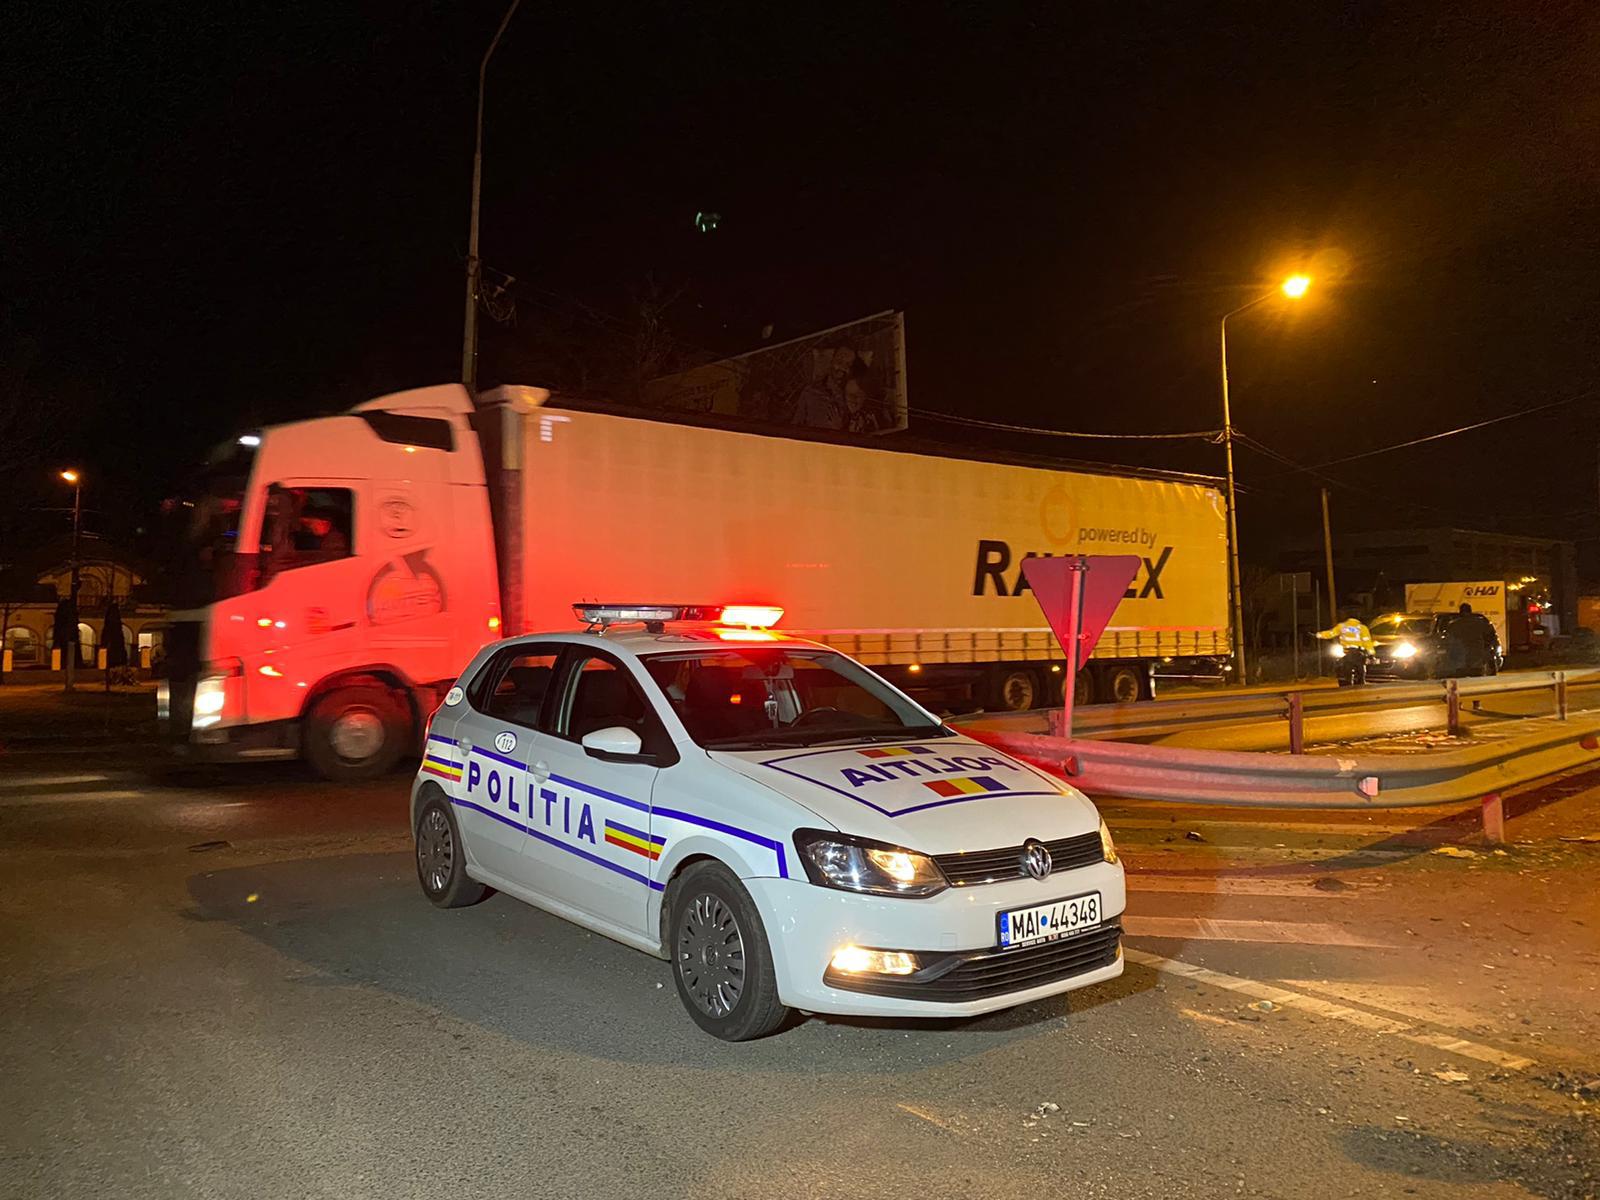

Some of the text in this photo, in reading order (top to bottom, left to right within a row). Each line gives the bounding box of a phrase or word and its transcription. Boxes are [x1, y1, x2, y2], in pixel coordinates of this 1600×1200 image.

[1077, 527, 1157, 549] powered by
[502, 738, 513, 751] 112
[467, 760, 597, 845] POLITIA
[1012, 910, 1040, 941] MAI
[1049, 898, 1097, 931] 44348
